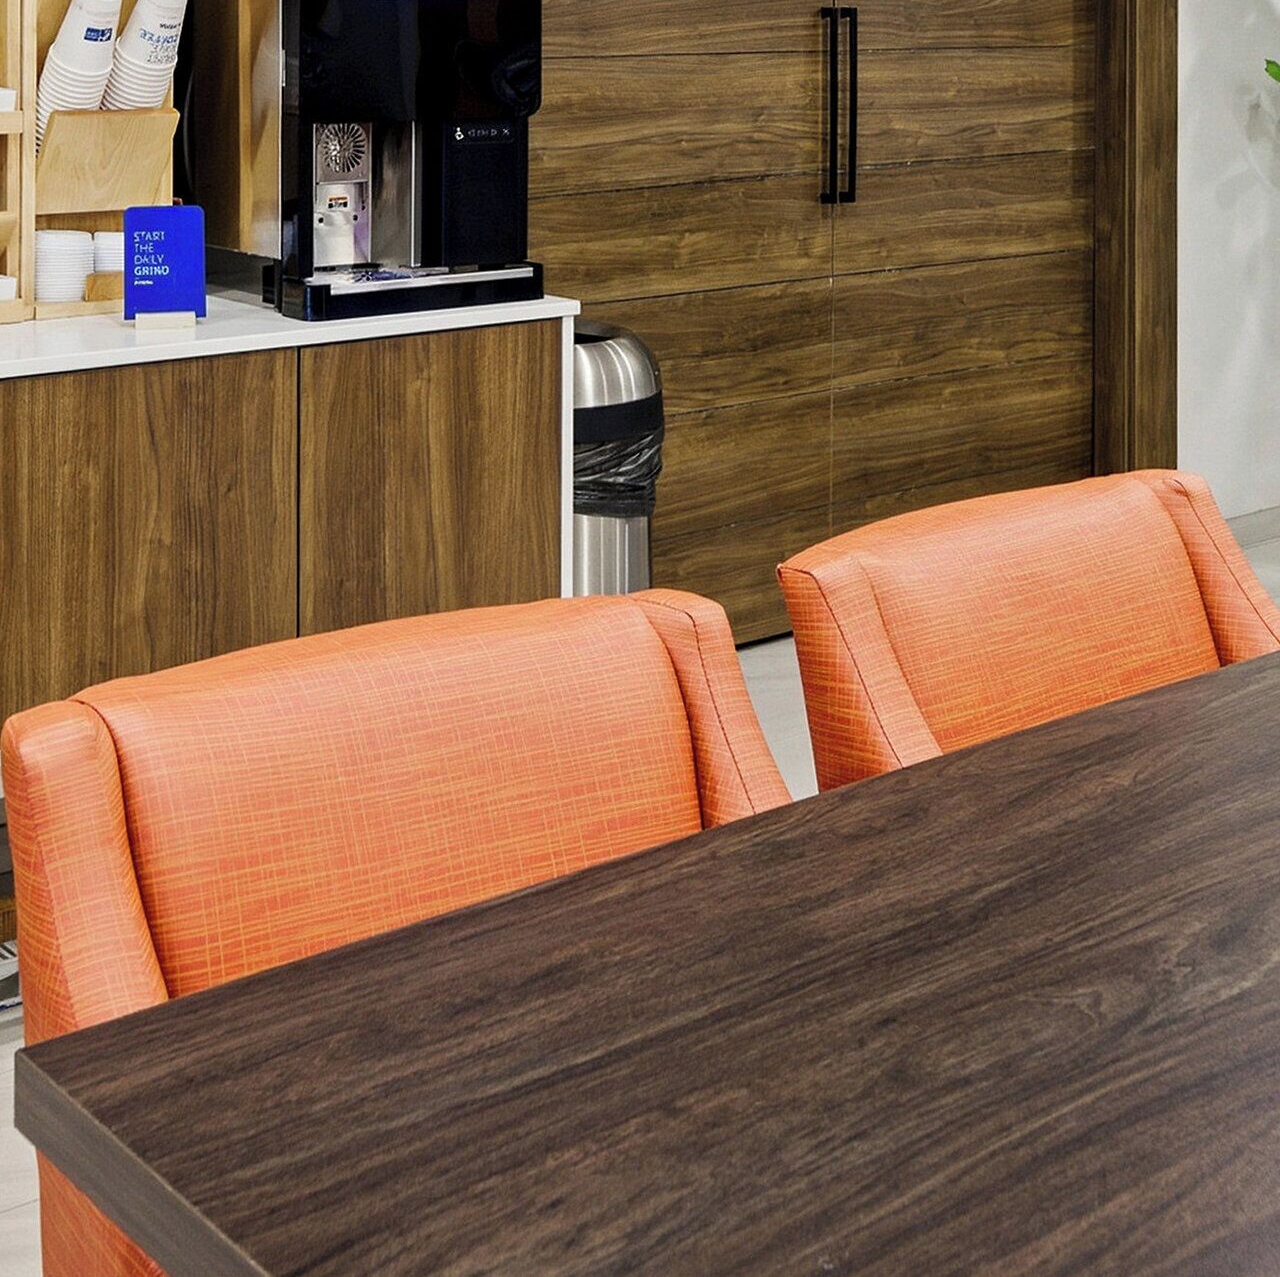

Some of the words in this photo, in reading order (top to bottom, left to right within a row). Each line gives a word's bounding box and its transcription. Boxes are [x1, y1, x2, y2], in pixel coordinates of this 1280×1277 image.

[134, 231, 165, 242] START
[134, 243, 154, 253] THE
[134, 265, 170, 276] GRIND
